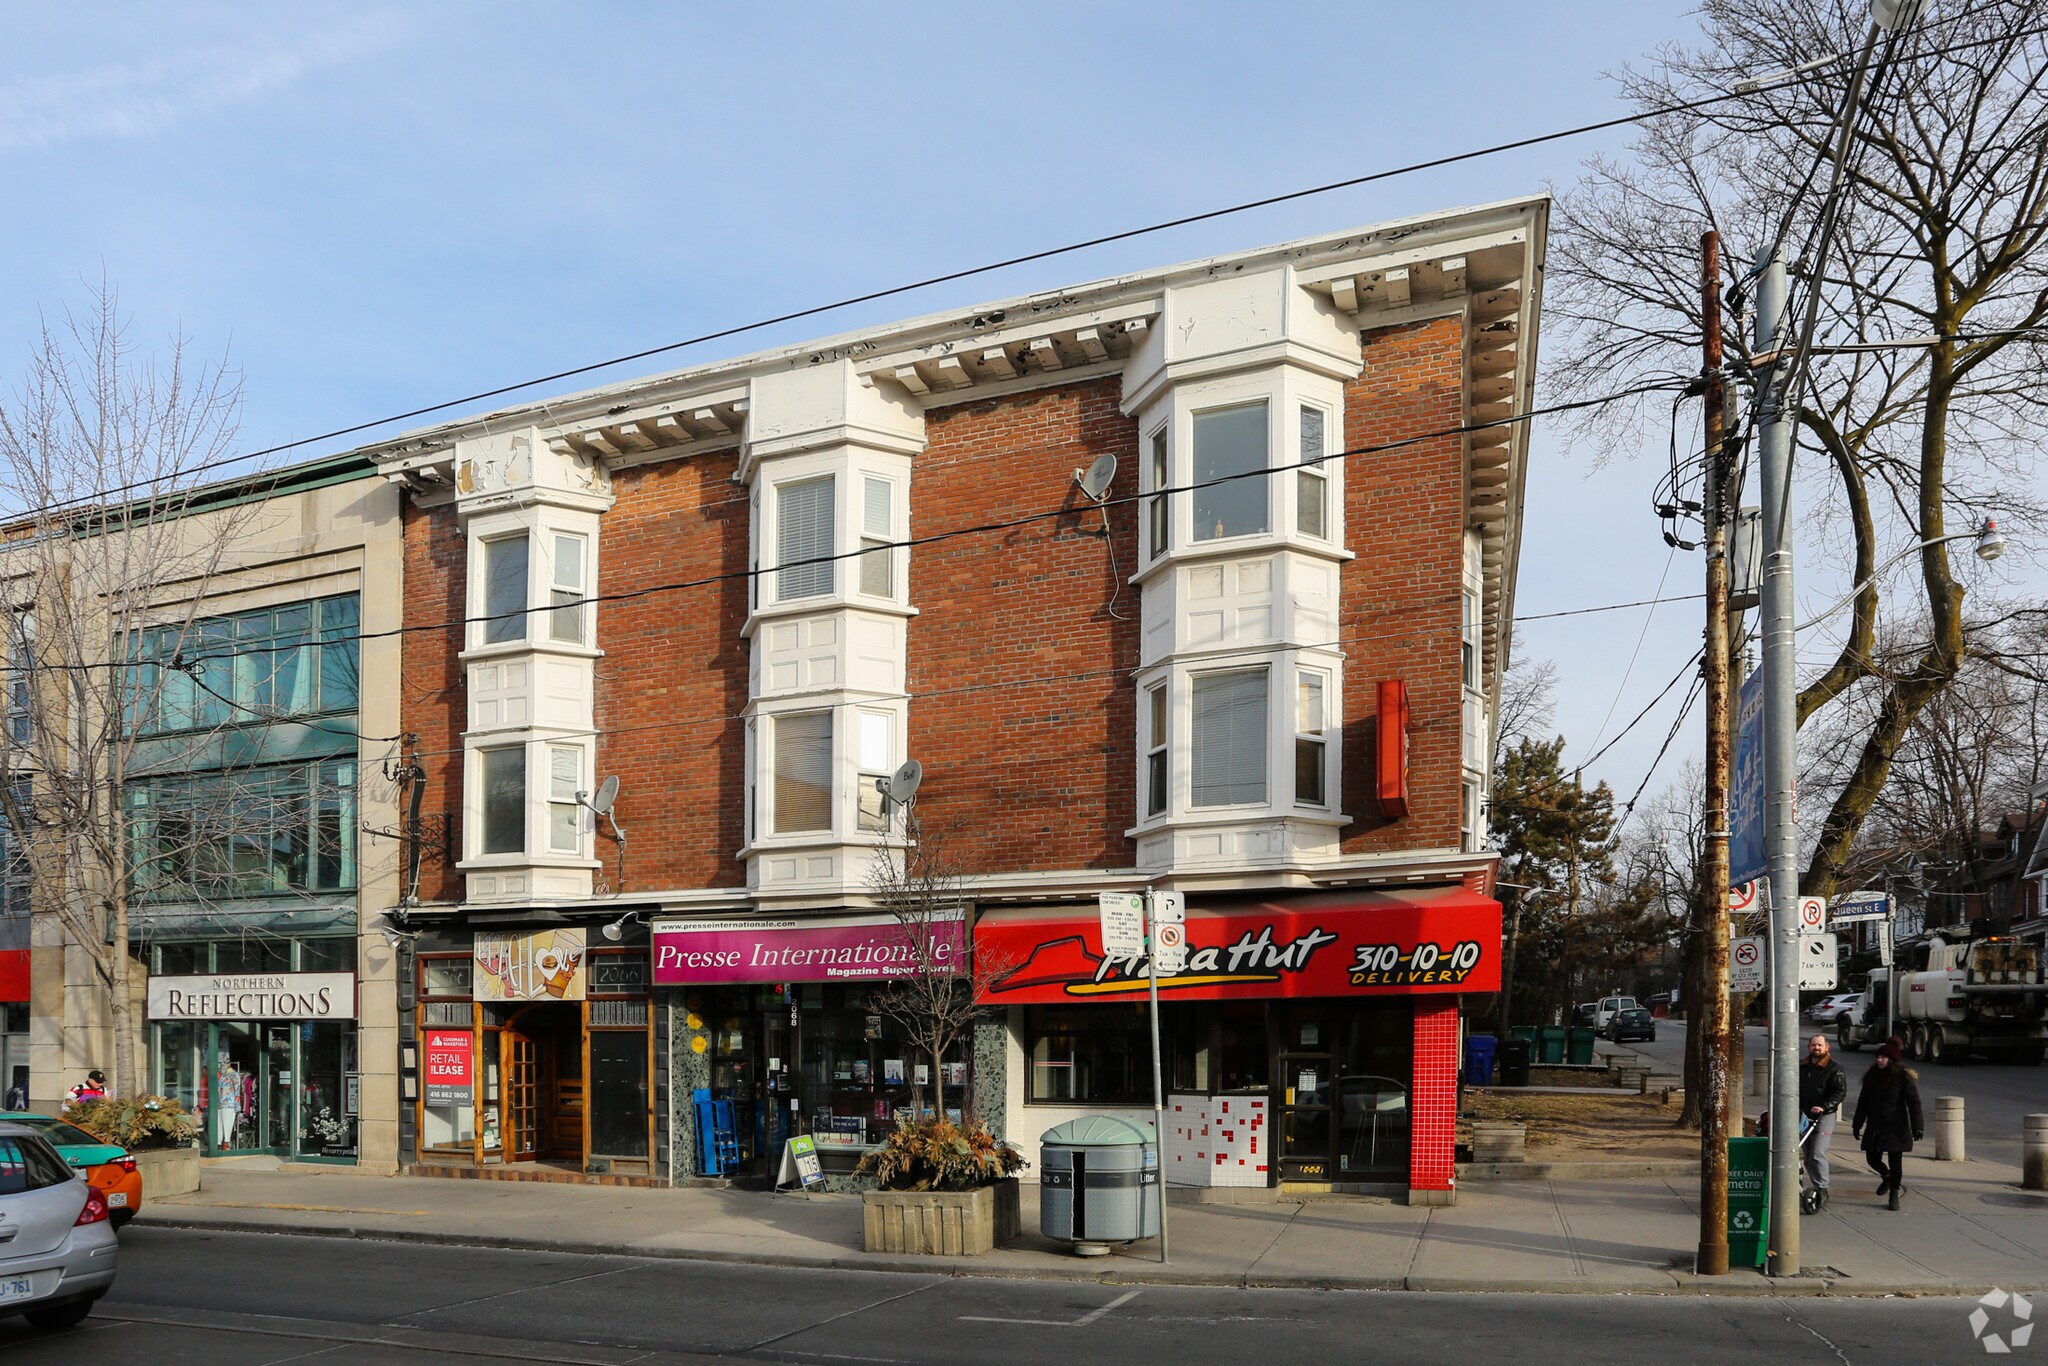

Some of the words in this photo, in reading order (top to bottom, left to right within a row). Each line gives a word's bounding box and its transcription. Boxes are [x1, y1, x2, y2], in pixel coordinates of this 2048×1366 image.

[1874, 902, 1880, 911] E
[661, 920, 796, 930] www.presseinternationale.com
[1228, 927, 1337, 972] Hut
[656, 945, 741, 969] Presse
[1349, 943, 1479, 972] 310-10-10
[1801, 961, 1814, 969] 7AM
[1820, 961, 1834, 969] 9AM
[827, 966, 879, 977] Magazine
[882, 966, 914, 976] Super
[1351, 970, 1469, 984] DELIVERY
[212, 976, 287, 990] NORTHERN
[168, 987, 332, 1017] REFLECTIONS
[430, 1053, 463, 1064] RETAIL
[434, 1065, 464, 1075] LEASE
[1140, 1174, 1155, 1183] Litter
[1728, 1170, 1742, 1178] REE
[1743, 1170, 1765, 1178] DAILY
[1728, 1180, 1761, 1190] metro
